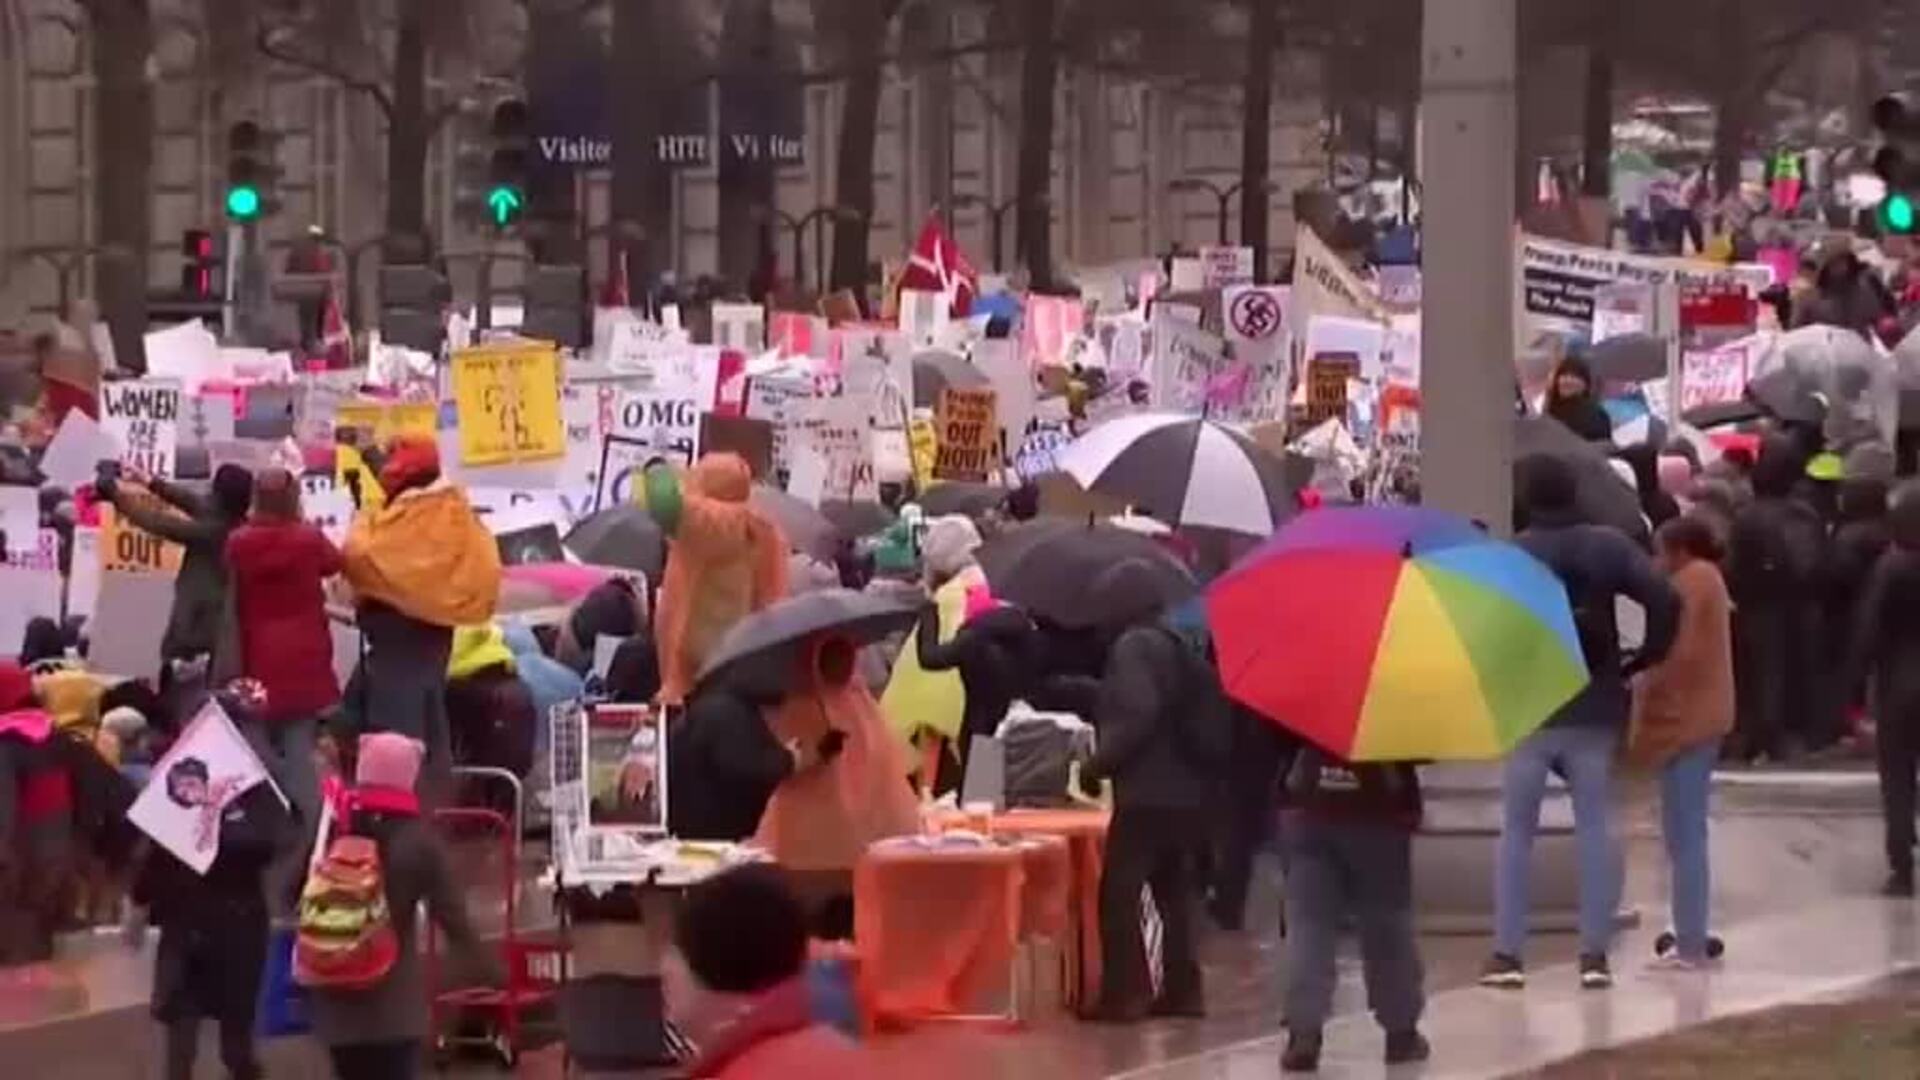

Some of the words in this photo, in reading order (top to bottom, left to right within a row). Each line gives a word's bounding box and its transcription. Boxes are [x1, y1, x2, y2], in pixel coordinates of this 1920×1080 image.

[104, 386, 178, 420] WOMEN
[623, 401, 695, 428] OMG
[947, 421, 983, 444] OUT
[118, 531, 163, 568] OUT
